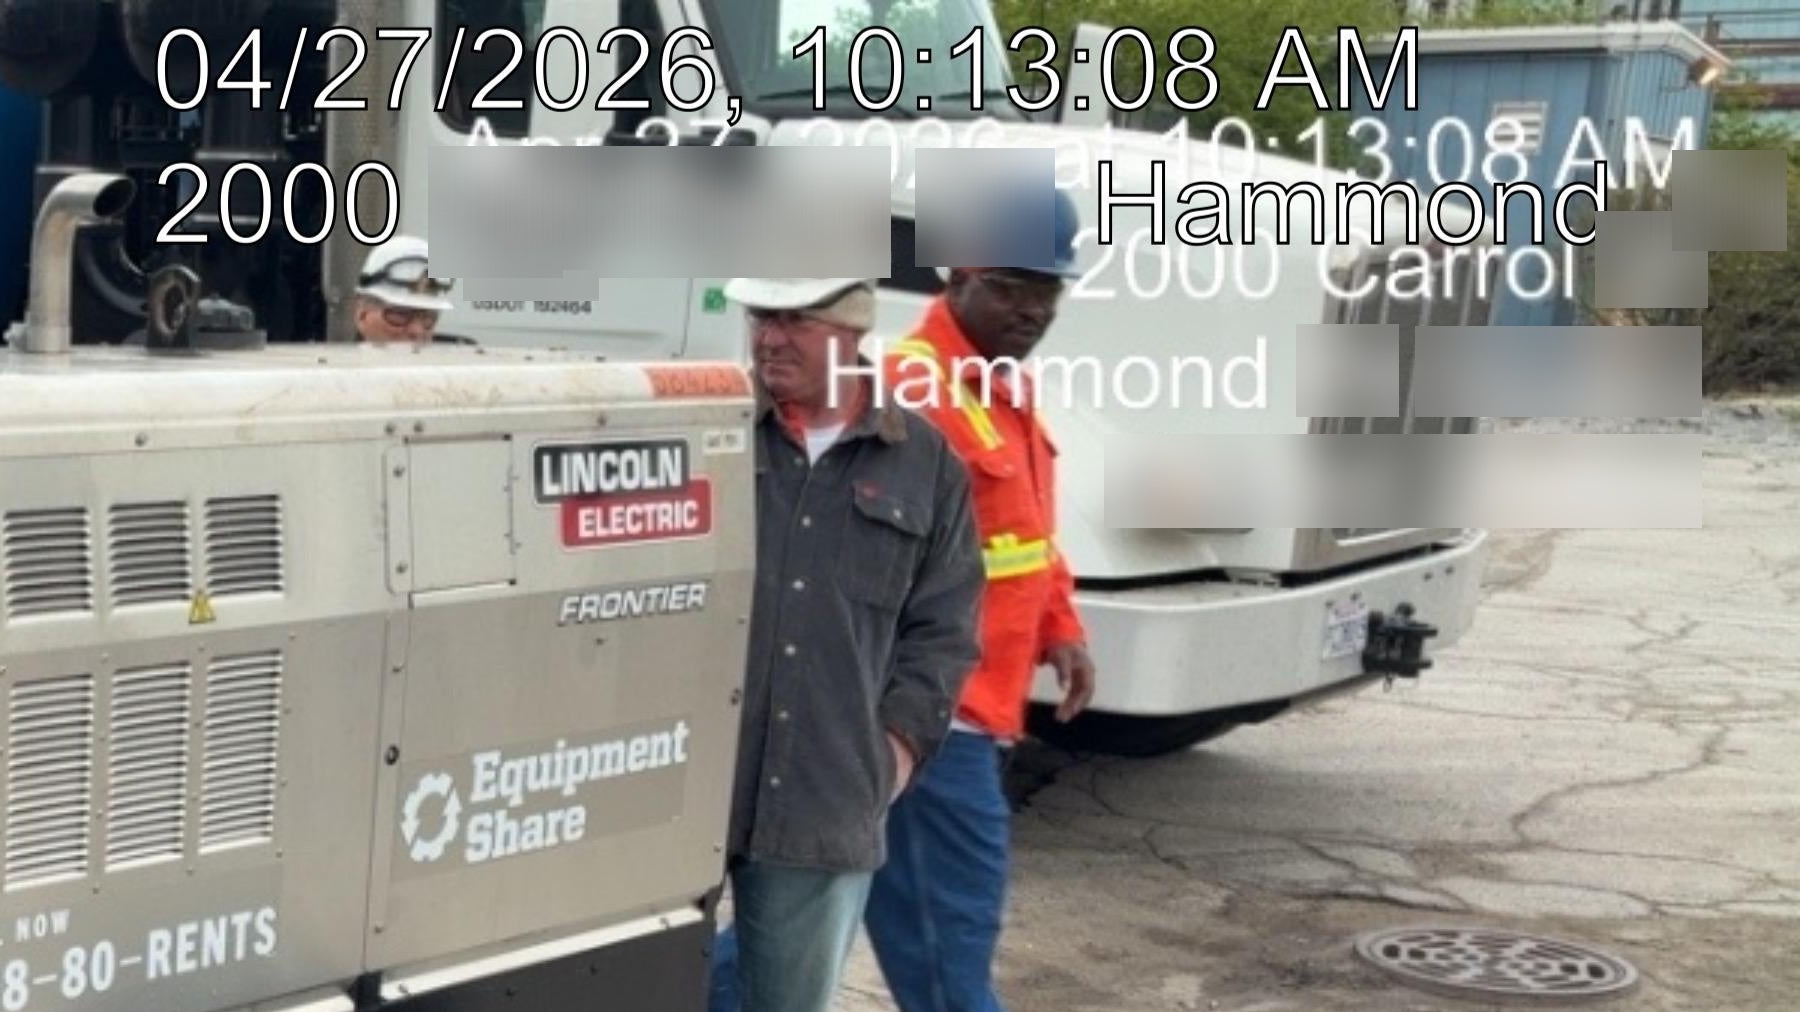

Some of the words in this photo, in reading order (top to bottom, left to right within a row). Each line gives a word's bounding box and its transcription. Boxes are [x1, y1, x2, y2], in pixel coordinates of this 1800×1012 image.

[541, 445, 684, 497] LINCOLN
[577, 499, 699, 539] ELECTRIC
[557, 580, 709, 623] FRONTIER
[469, 719, 691, 808] Equipment
[464, 803, 587, 864] Share
[15, 908, 71, 942] NOW
